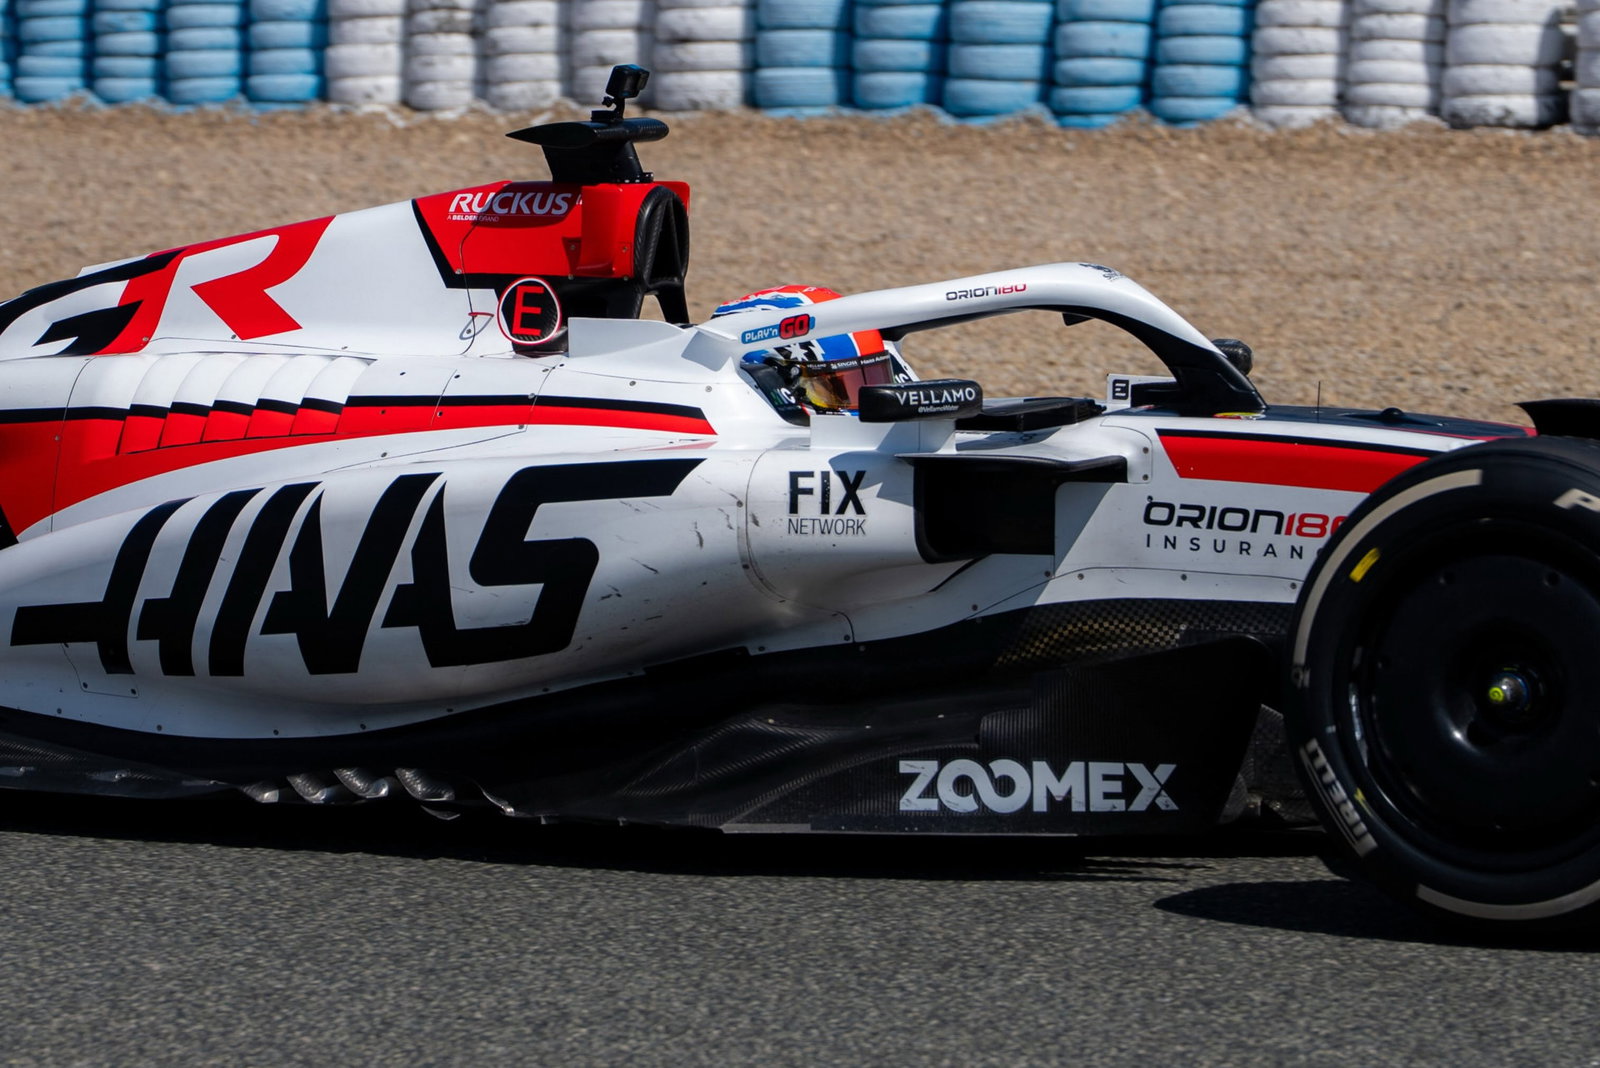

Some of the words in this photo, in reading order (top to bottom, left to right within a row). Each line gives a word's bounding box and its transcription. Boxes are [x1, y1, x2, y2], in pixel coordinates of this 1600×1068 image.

[448, 192, 572, 214] RUCKUS
[512, 285, 545, 336] E
[780, 314, 810, 340] GO
[896, 387, 976, 406] VELLAMO
[788, 470, 867, 515] FIX
[788, 518, 866, 535] NETWORK
[10, 457, 707, 677] HAAS
[899, 758, 1180, 814] ZOOMEX
